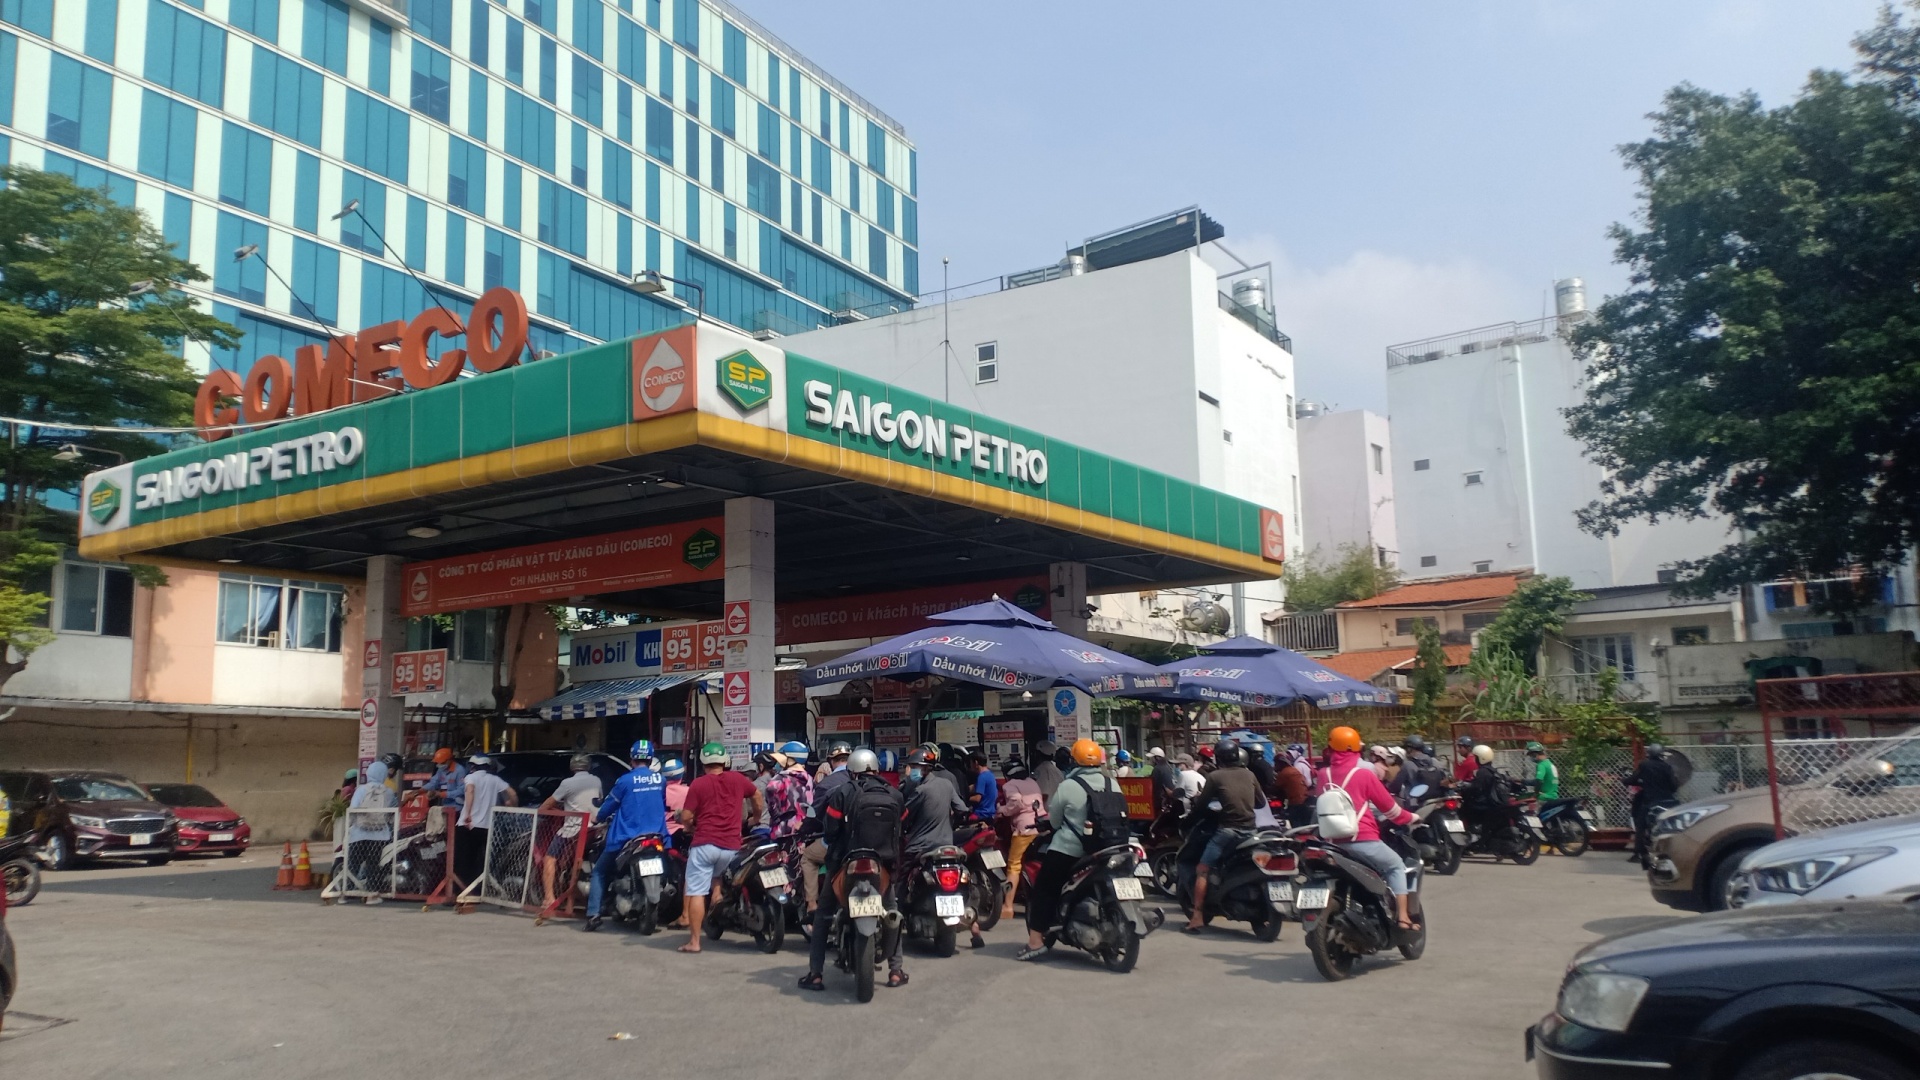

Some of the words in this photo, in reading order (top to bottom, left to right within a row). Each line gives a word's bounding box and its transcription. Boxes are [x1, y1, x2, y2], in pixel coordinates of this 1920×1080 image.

[194, 286, 528, 442] COMECO
[728, 361, 766, 384] SP
[644, 370, 685, 388] COMECO
[729, 380, 749, 391] SAIGON
[749, 385, 765, 395] PETRO
[804, 379, 947, 457] SAIGON
[952, 424, 1048, 484] PETRO
[136, 452, 249, 510] SAIGON
[249, 426, 363, 486] PETRO
[91, 489, 113, 507] SP
[439, 564, 465, 579] CÔNG
[466, 563, 479, 574] TY
[619, 533, 673, 555] (COMECO)
[688, 539, 716, 555] SP
[510, 575, 525, 587] CHI
[577, 567, 588, 578] 16
[792, 610, 847, 628] COMECO
[866, 604, 908, 621] khách
[671, 628, 689, 638] RON
[707, 624, 724, 634] RON
[576, 640, 627, 667] Mobil
[666, 638, 692, 660] 95
[702, 635, 725, 657] 95
[399, 656, 413, 664] RON
[425, 654, 440, 663] RON
[817, 667, 836, 679] Dầu
[838, 662, 864, 676] nhớt
[867, 653, 908, 671] Mobil
[932, 656, 956, 671] Dầu
[958, 665, 987, 679] nhớt
[395, 664, 415, 684] 95
[422, 662, 442, 682] 95
[782, 679, 801, 694] 95
[1200, 686, 1218, 698] Dầu
[1219, 691, 1242, 702] nhớt
[839, 720, 861, 728] COMECO
[1127, 802, 1151, 815] TRONG
